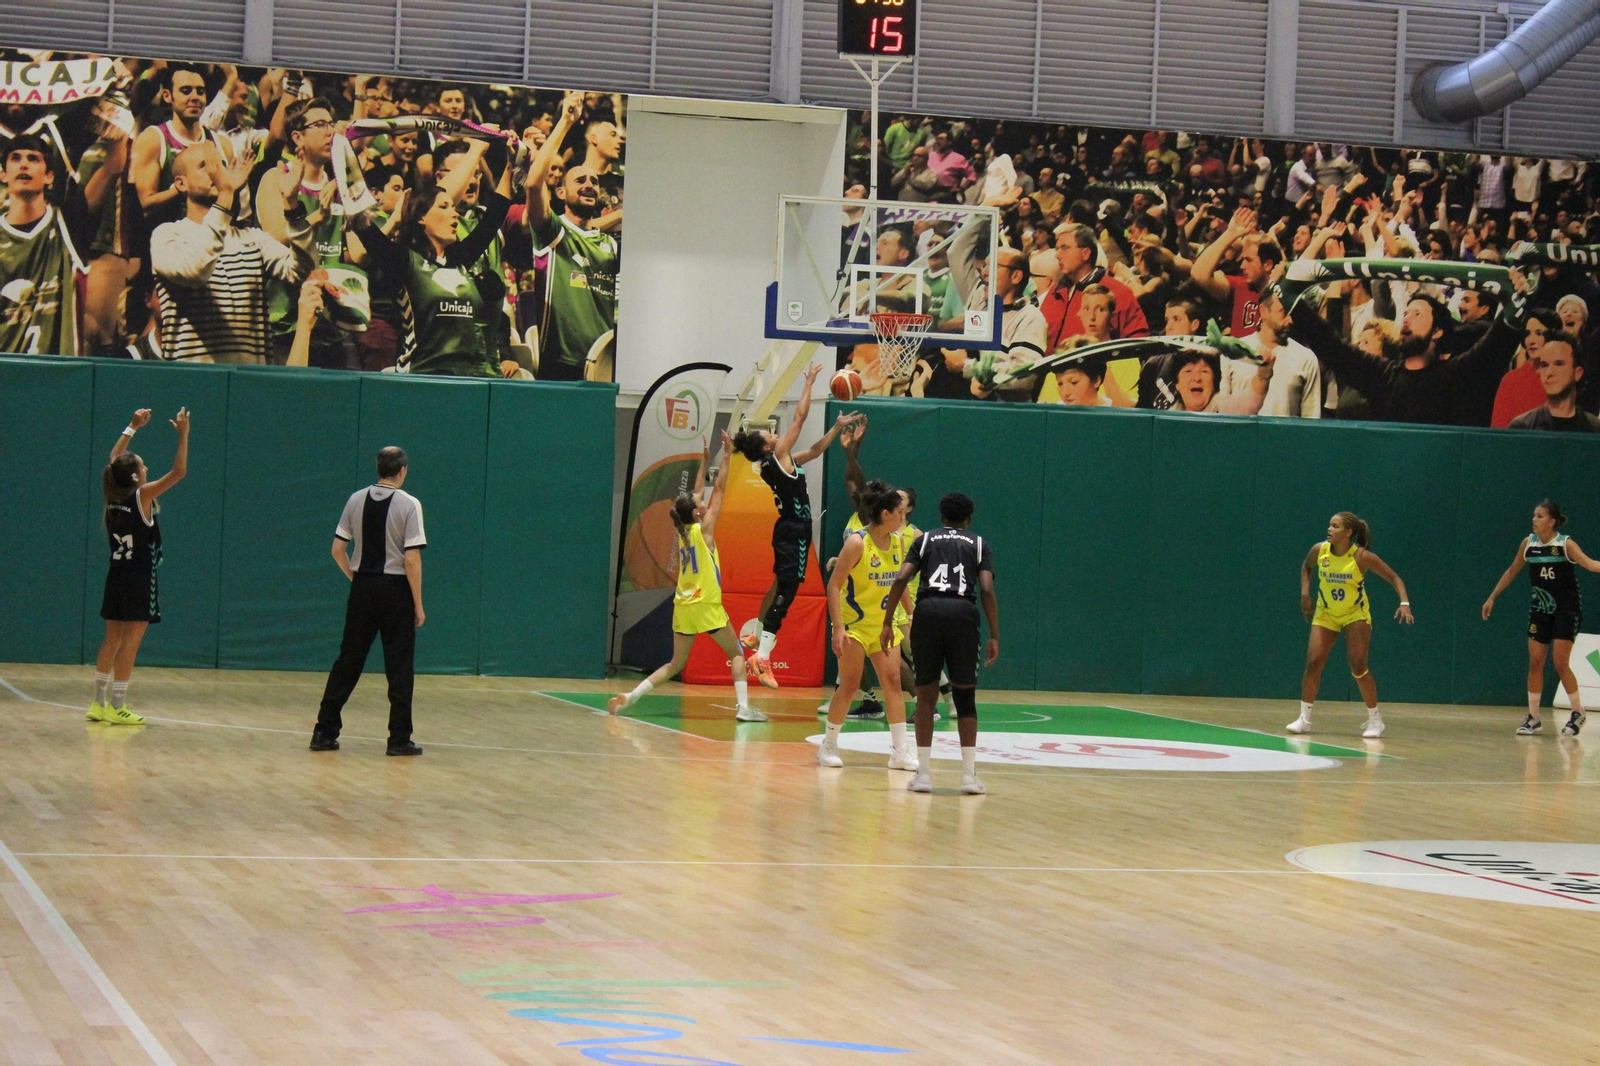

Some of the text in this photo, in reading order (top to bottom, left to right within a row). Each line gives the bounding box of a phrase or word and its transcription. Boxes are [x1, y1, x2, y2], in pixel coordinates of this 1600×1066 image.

[870, 16, 903, 51] 15
[440, 300, 473, 316] Unicaja
[929, 563, 966, 596] 41
[1540, 567, 1555, 580] 46
[1331, 588, 1345, 601] 69
